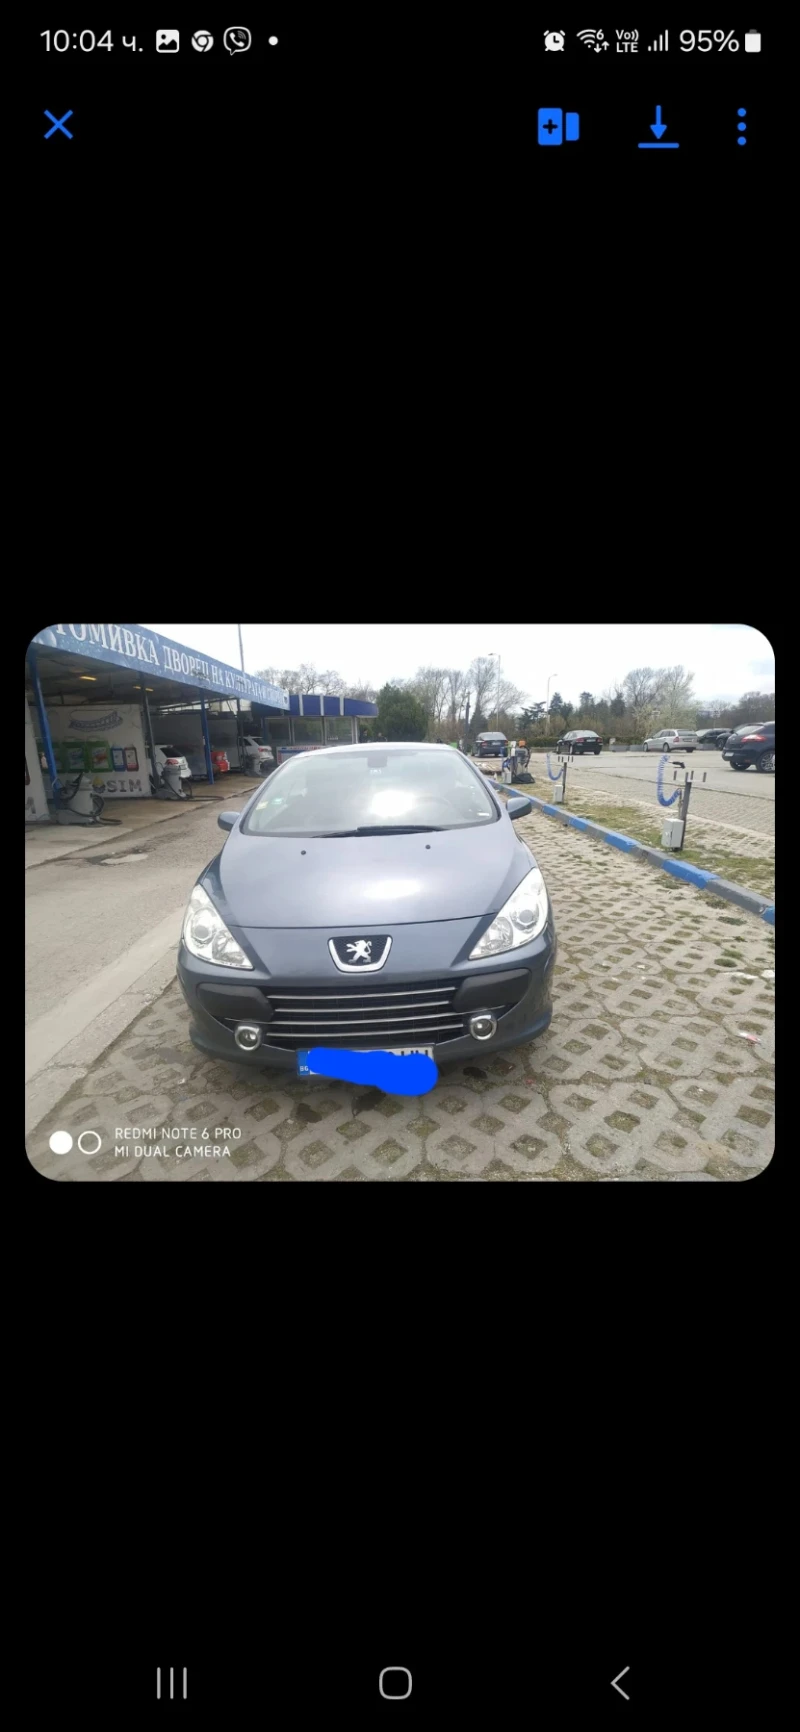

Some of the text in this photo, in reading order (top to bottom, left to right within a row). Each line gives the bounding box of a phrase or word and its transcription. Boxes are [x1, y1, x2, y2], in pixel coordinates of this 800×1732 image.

[40, 29, 144, 52] 10:04 ч.
[616, 41, 639, 53] LTE
[679, 29, 740, 52] 95%
[162, 645, 210, 682] ДВОРЕЦ
[211, 664, 224, 686] НА
